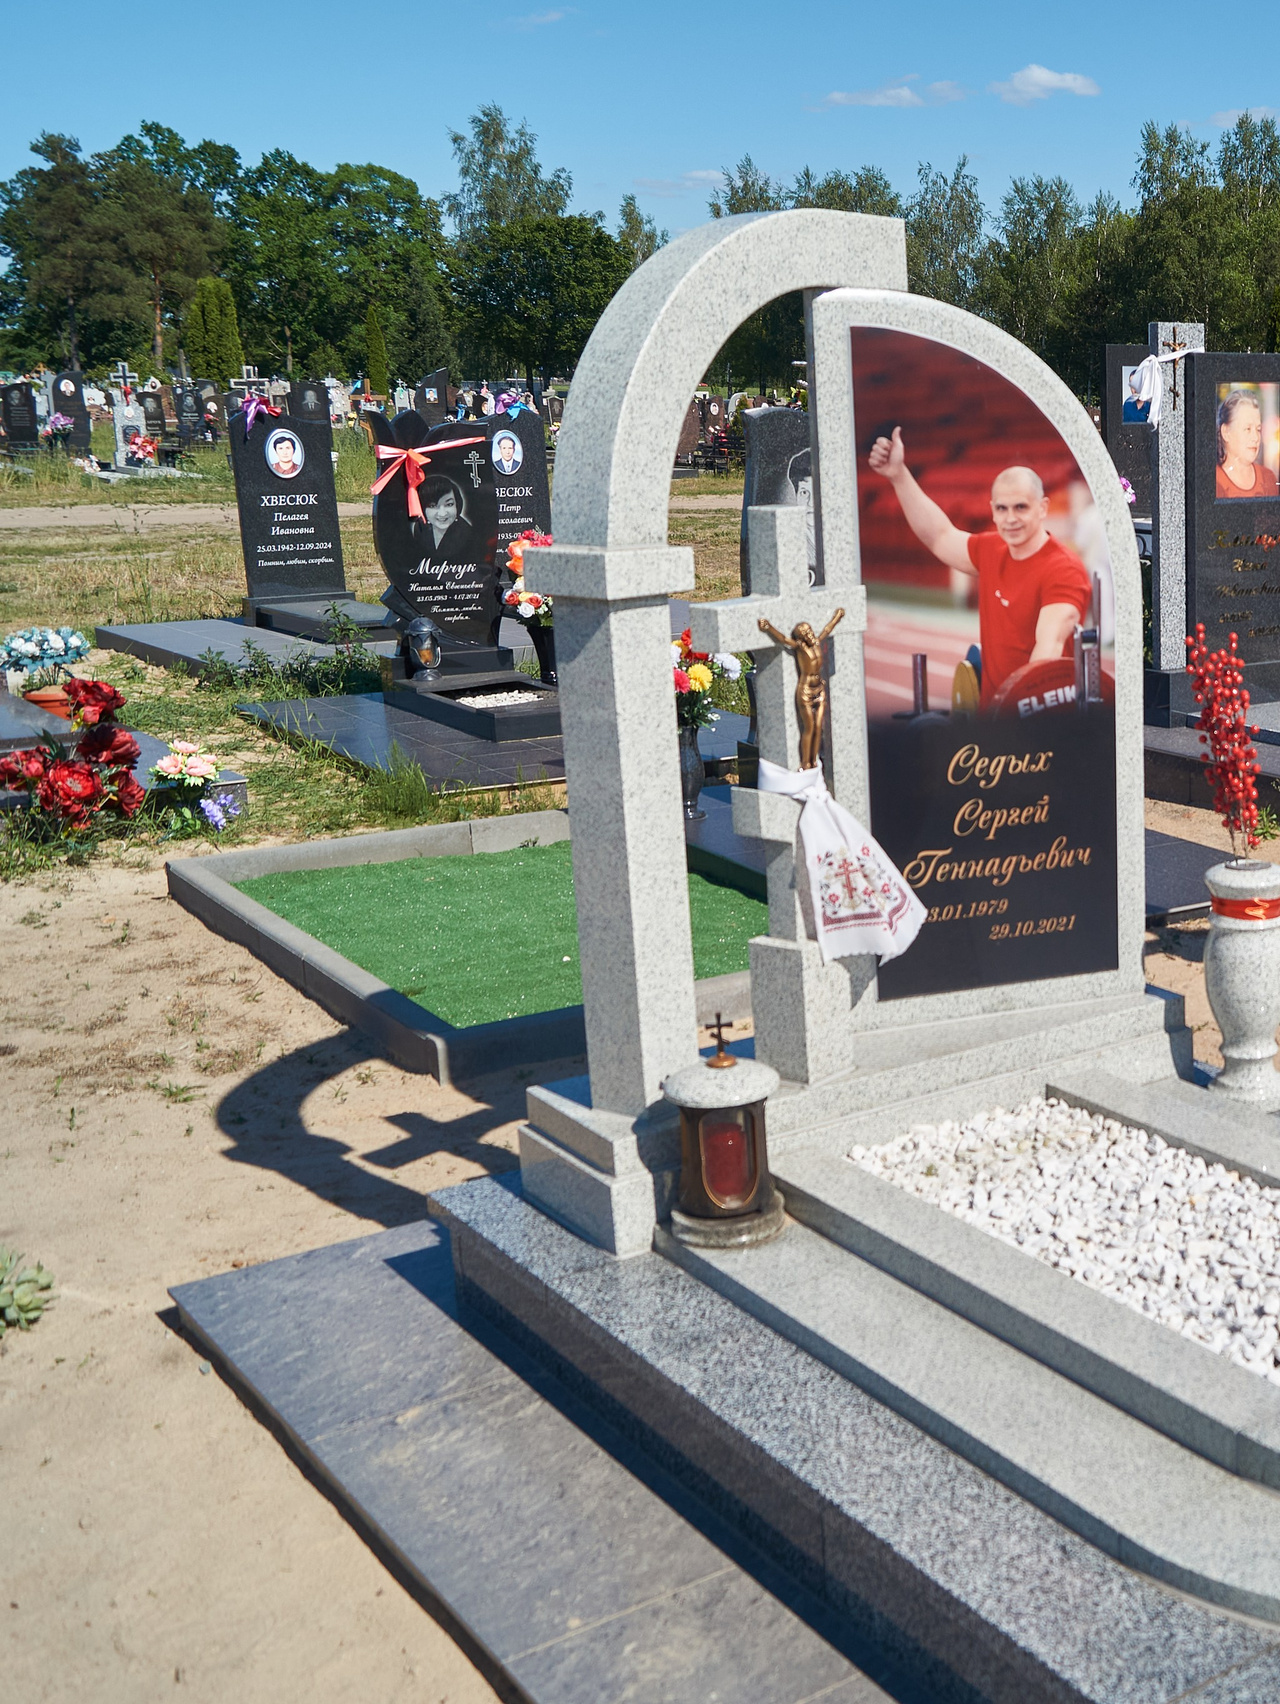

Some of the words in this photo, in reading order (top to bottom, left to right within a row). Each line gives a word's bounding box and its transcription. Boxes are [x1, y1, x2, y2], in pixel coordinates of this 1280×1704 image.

[260, 493, 318, 507] ХВЕСЮК
[273, 512, 309, 522] Пелагея
[271, 526, 315, 536] Ивановна
[256, 541, 332, 553] 25.03.1942-12.09.2024
[408, 557, 477, 581] Марчук
[408, 582, 444, 592] Наталья
[947, 743, 1053, 789] Седых
[953, 795, 1050, 841] Сергей
[902, 835, 1092, 889] Геннадьевич
[924, 898, 1009, 924] 3.01.1979
[988, 914, 1077, 940] 29.10.2021
